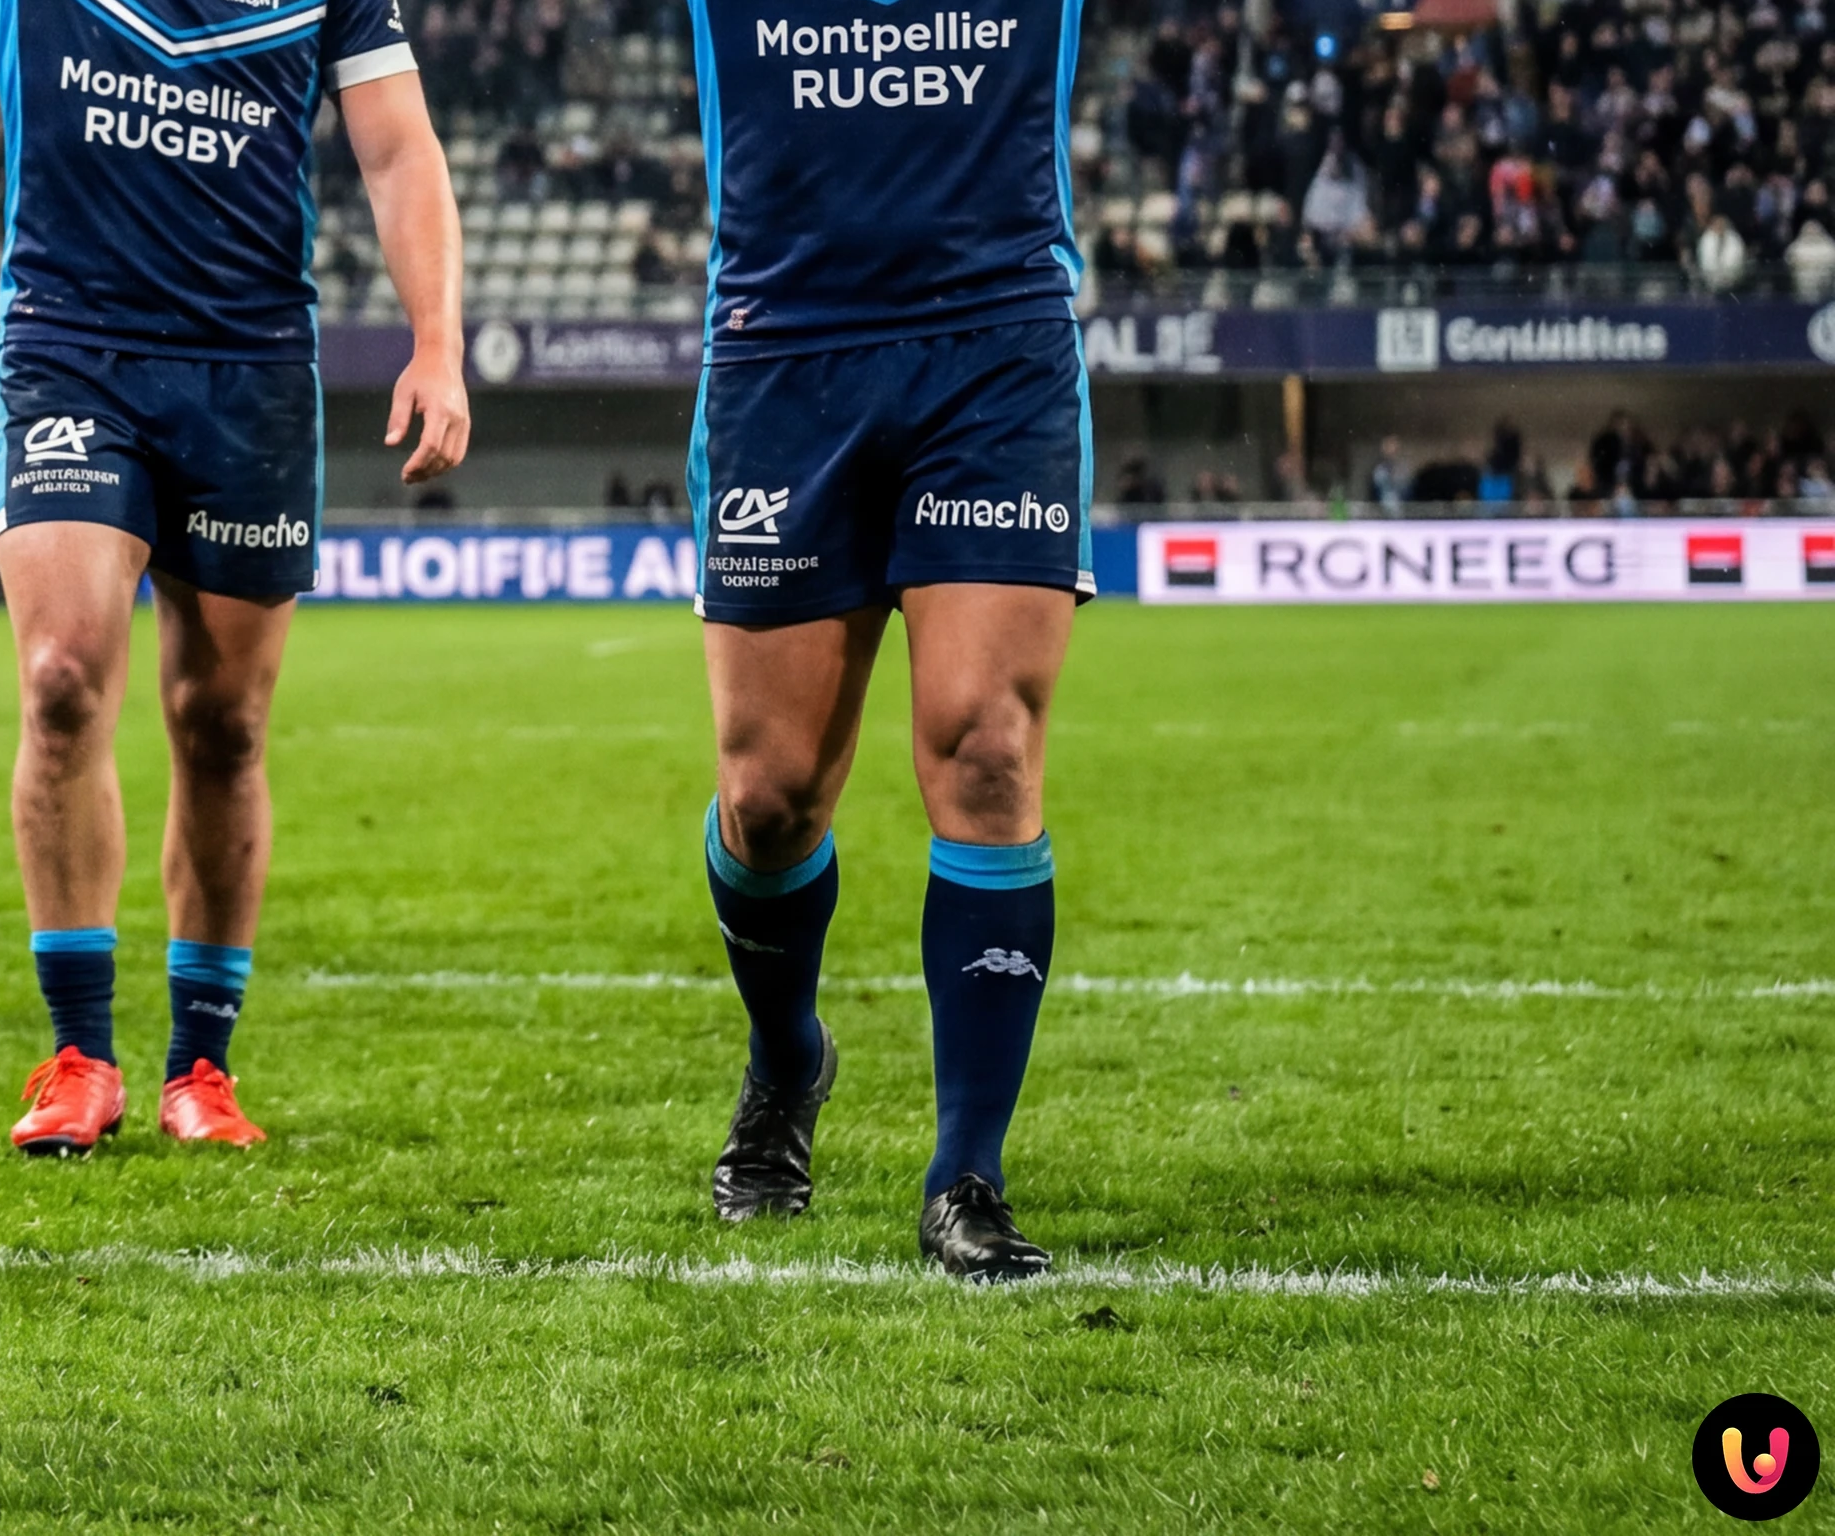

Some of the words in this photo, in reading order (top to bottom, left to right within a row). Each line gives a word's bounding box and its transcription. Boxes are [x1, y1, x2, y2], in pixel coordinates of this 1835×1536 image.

[756, 12, 1018, 62] Montpellier
[60, 57, 277, 128] Montpellier
[793, 64, 986, 110] RUGBY
[84, 106, 250, 169] RUGBY
